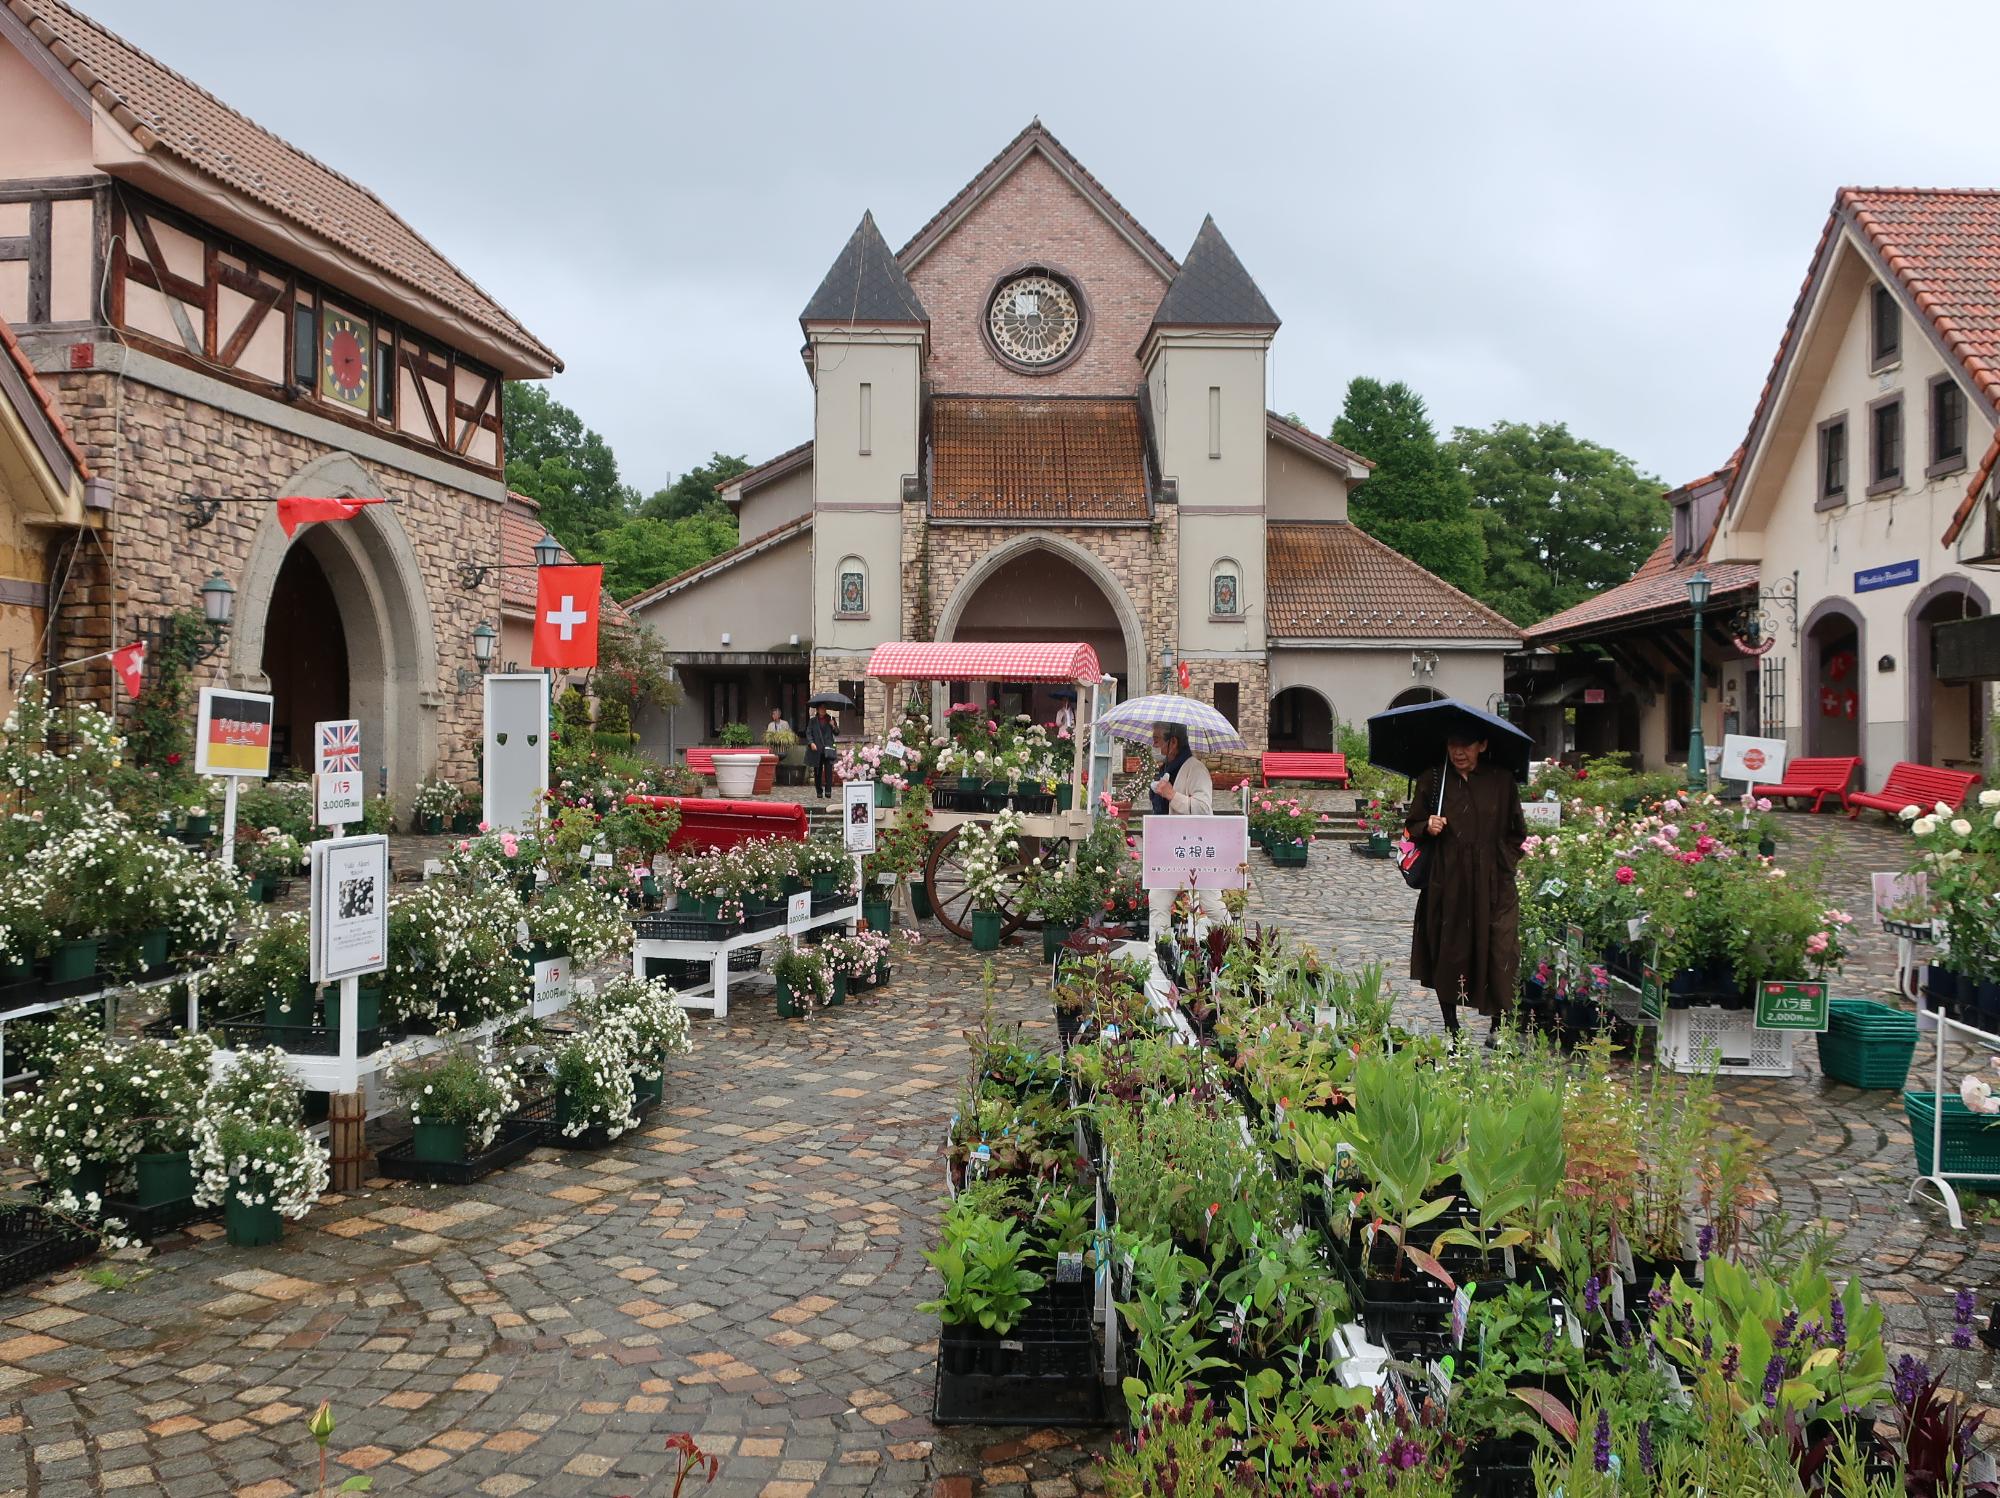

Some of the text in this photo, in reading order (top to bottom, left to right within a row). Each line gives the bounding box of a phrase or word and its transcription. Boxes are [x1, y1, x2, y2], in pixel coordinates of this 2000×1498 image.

[333, 781, 350, 794] バラ
[1174, 846, 1216, 859] 宿根草
[545, 967, 560, 984] バラ
[1775, 998, 1813, 1010] バラ苗
